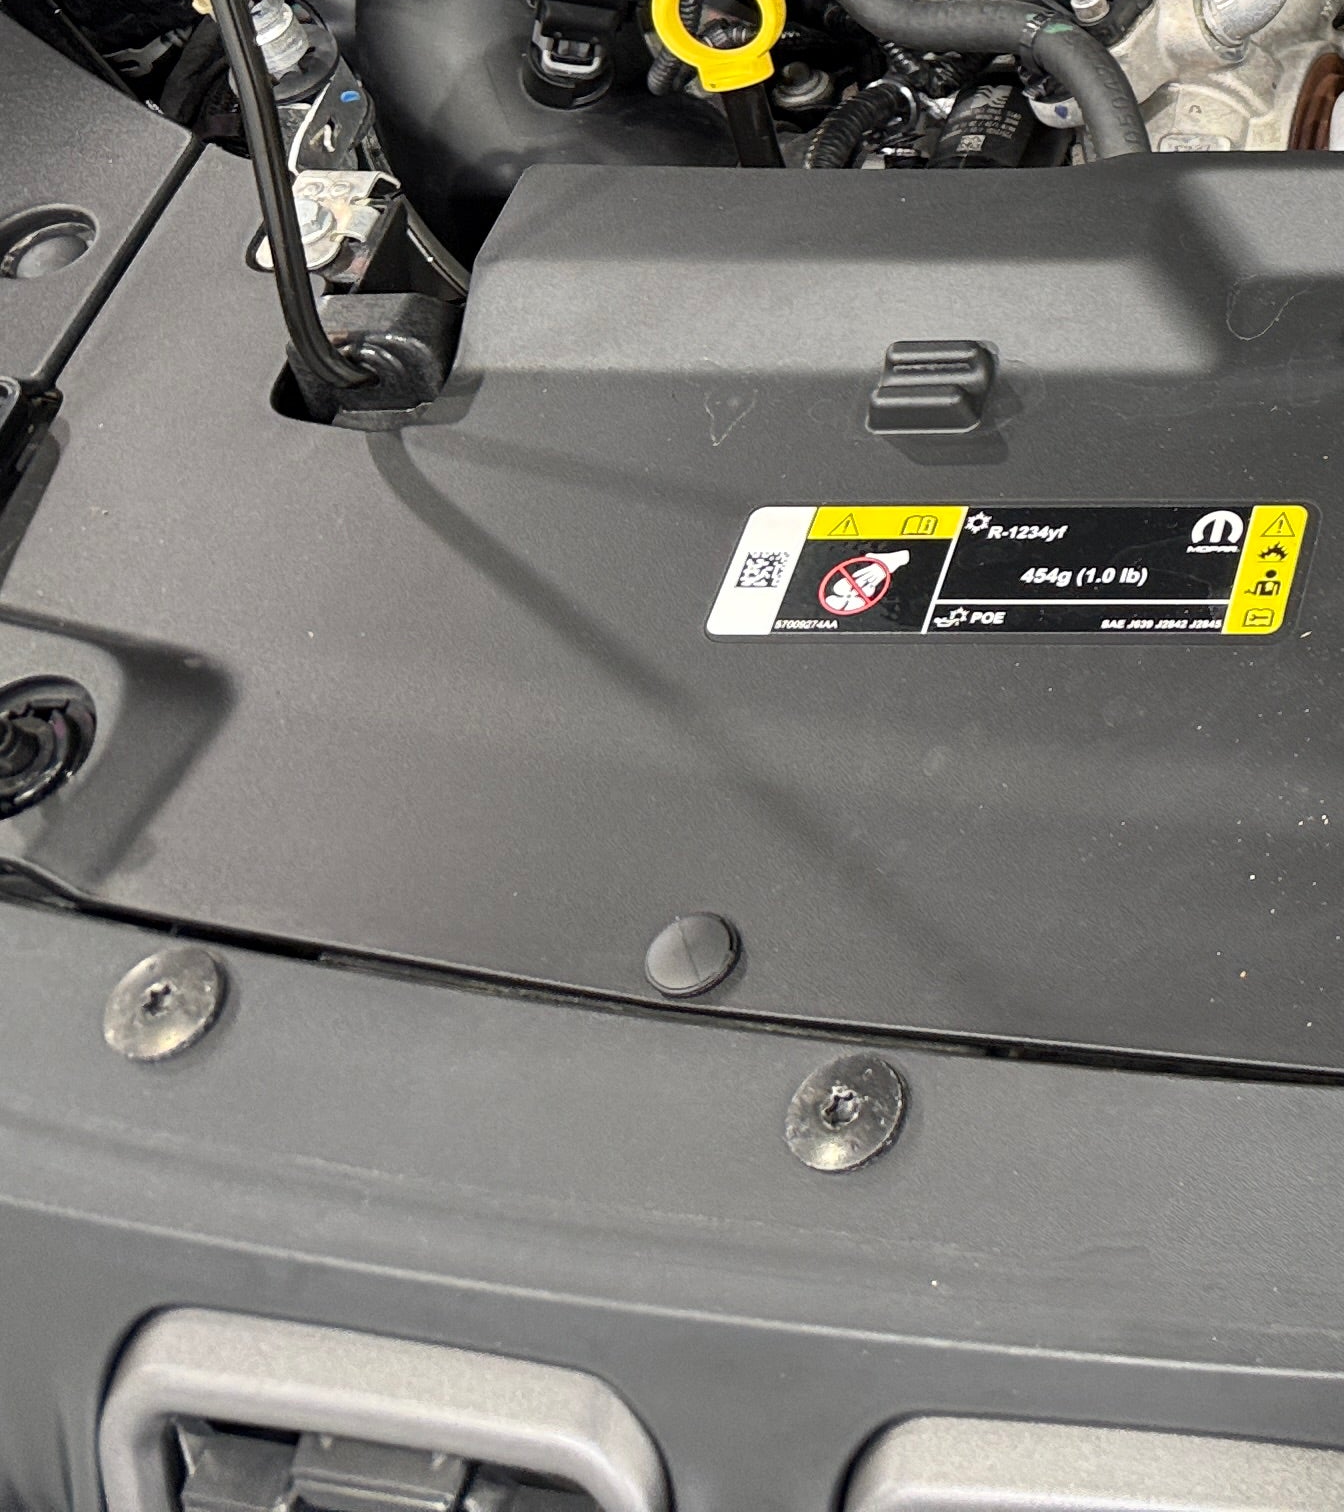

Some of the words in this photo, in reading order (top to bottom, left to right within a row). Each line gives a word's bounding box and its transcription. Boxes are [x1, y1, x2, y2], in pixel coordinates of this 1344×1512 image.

[988, 524, 1067, 542] R-1234yf
[1019, 567, 1072, 587] 454g
[1076, 567, 1116, 587] (1.0
[1118, 567, 1149, 587] lb)
[970, 611, 1005, 625] POE
[1101, 619, 1126, 629] SAE
